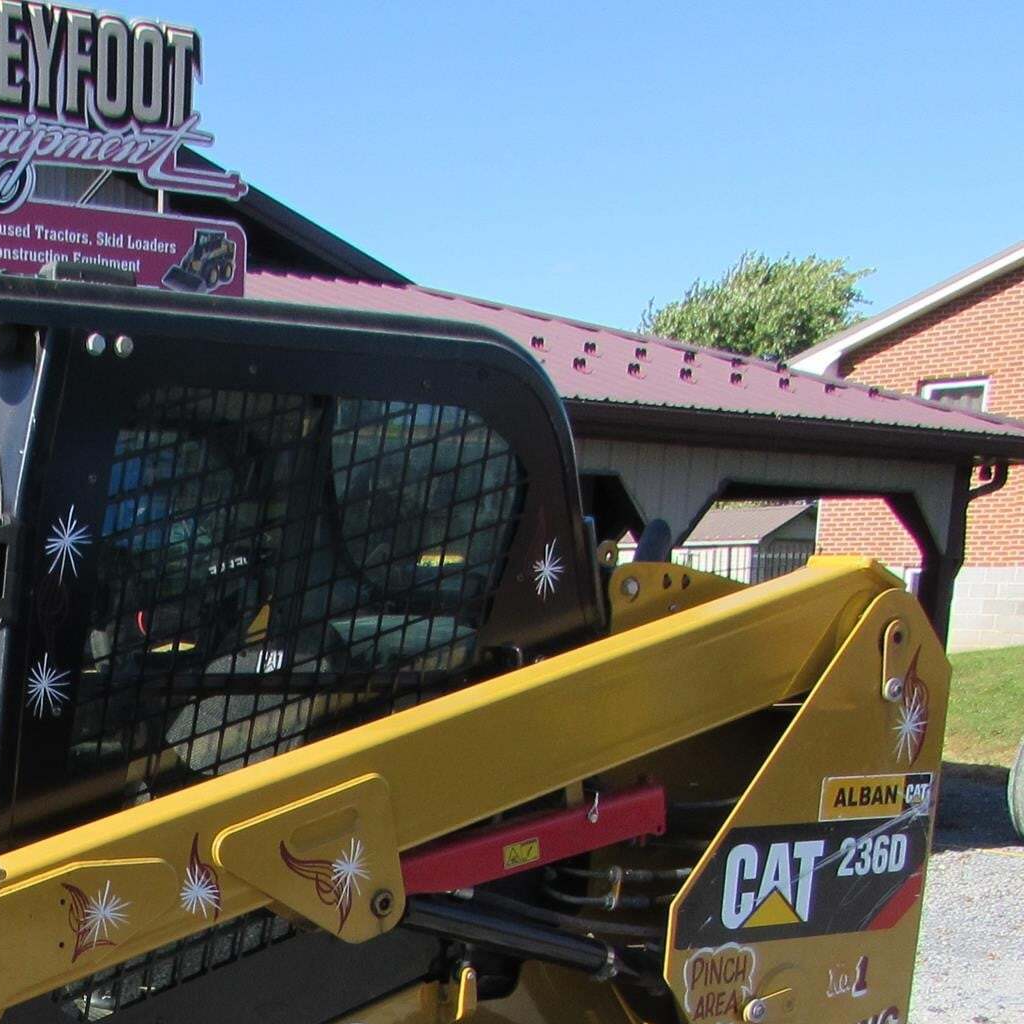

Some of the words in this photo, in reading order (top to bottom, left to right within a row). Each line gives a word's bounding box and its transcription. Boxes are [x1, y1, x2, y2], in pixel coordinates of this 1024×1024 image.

[0, 222, 31, 239] used
[96, 231, 124, 249] Skid
[126, 234, 177, 254] Loaders
[833, 784, 898, 808] ALBAN
[906, 783, 930, 804] CAT
[837, 833, 908, 877] 236D
[720, 840, 826, 930] CAT
[692, 989, 739, 1021] AREA
